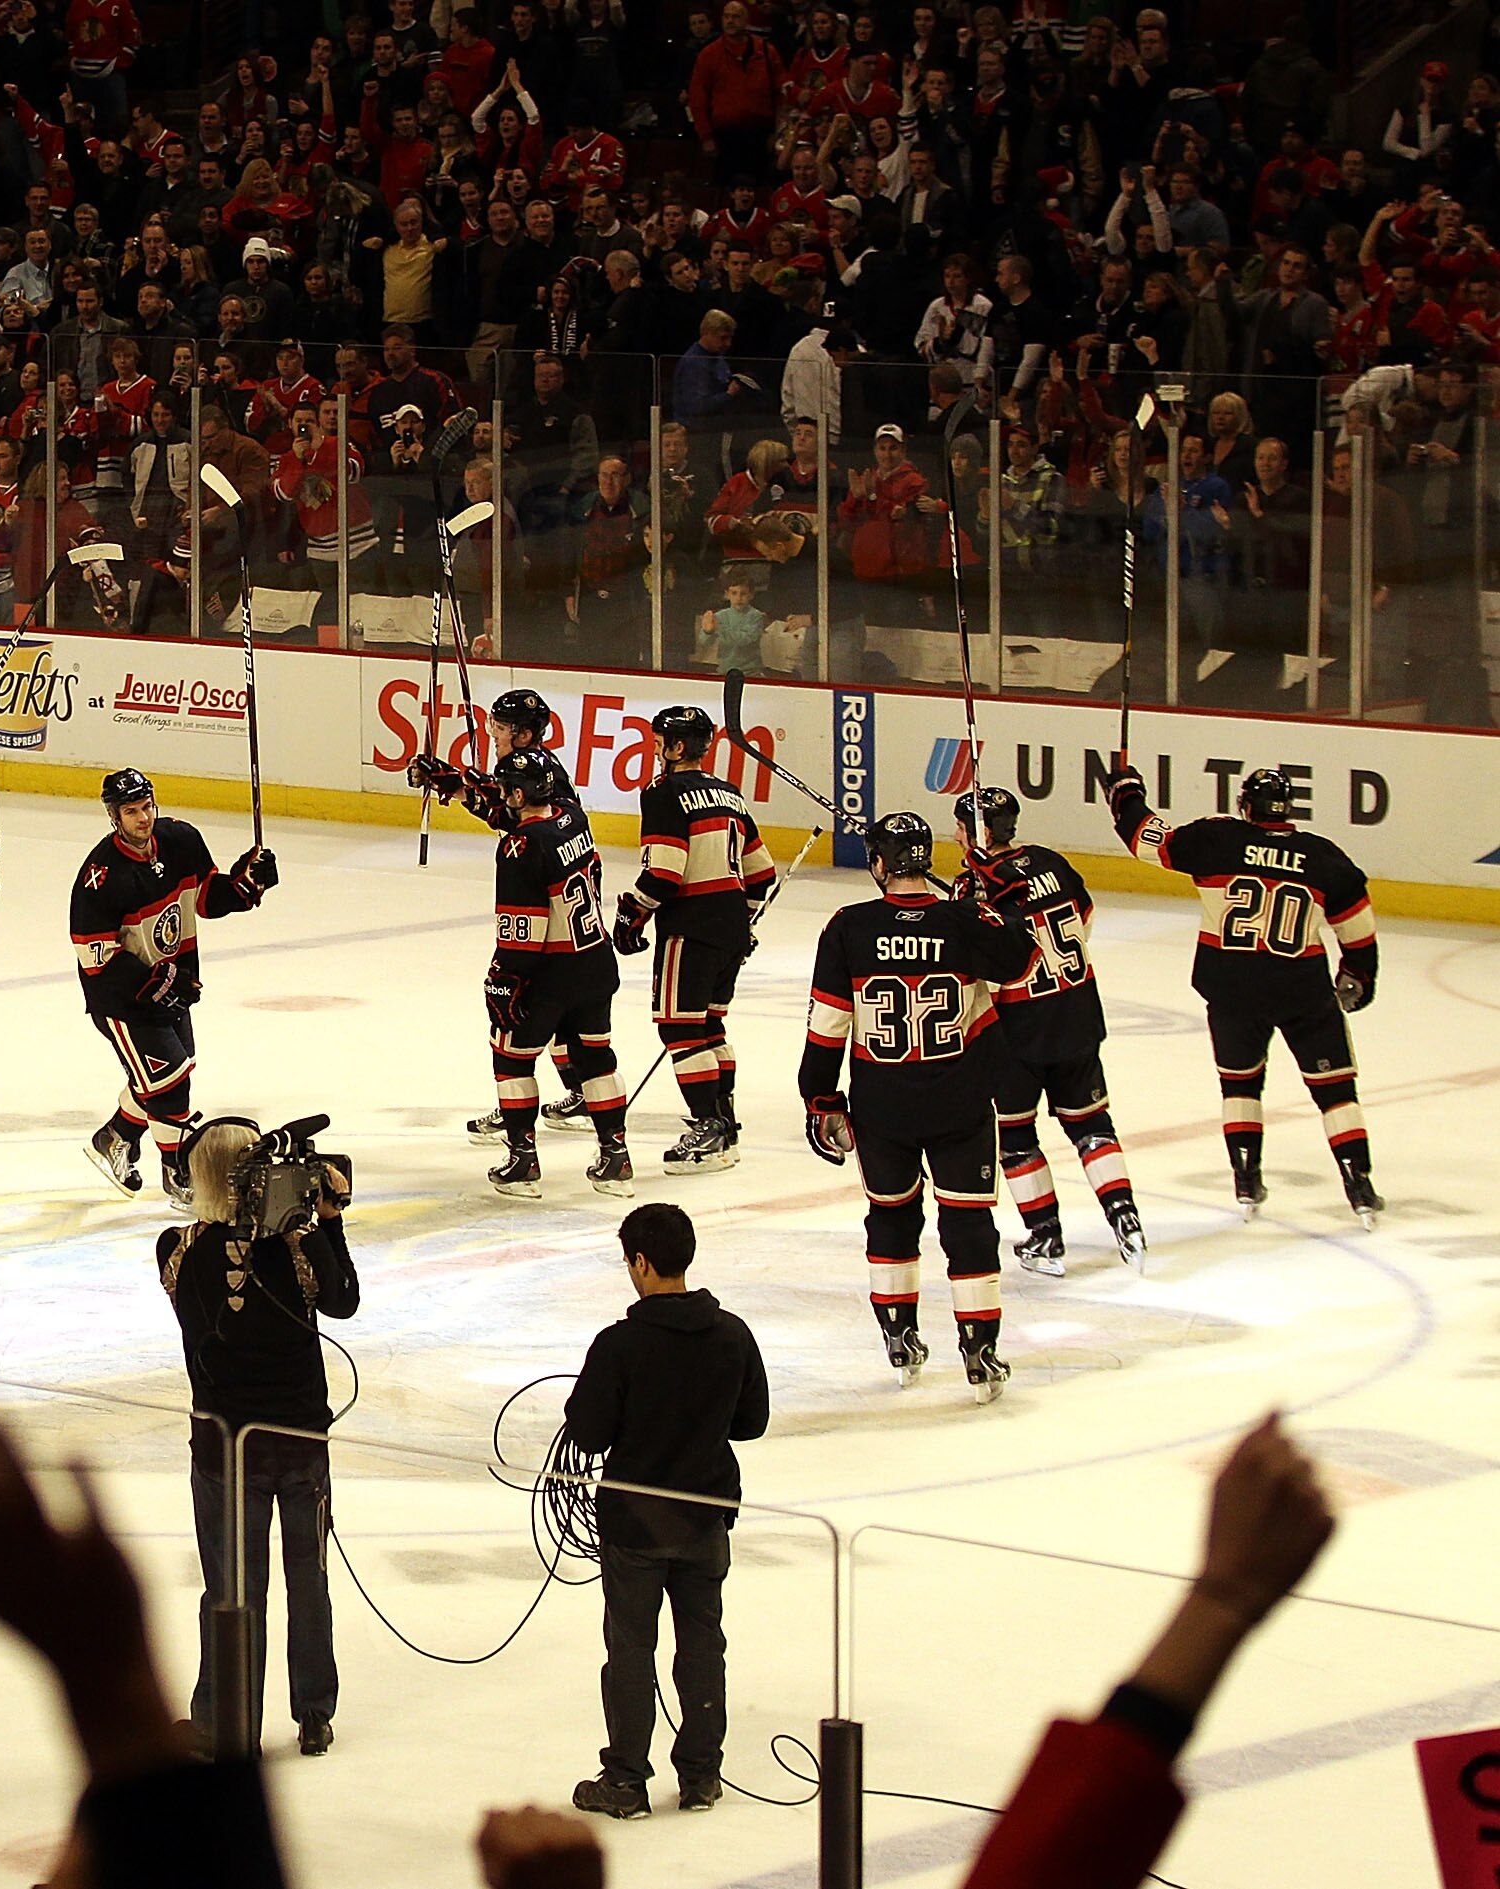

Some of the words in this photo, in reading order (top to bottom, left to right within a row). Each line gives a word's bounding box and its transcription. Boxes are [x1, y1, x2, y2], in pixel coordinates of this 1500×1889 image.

[88, 695, 105, 709] at
[115, 673, 249, 711] Jewel-Osco
[12, 732, 41, 747] SPREAD
[839, 694, 868, 836] Reebok
[1271, 801, 1285, 813] 20
[556, 830, 595, 867] DOWELL
[911, 845, 925, 858] 32
[1244, 845, 1307, 873] SKILLE
[497, 913, 532, 943] 28
[1220, 875, 1315, 958] 20
[88, 940, 105, 967] 7
[876, 936, 944, 962] SCOTT
[1025, 901, 1089, 999] 15
[860, 972, 964, 1063] 32
